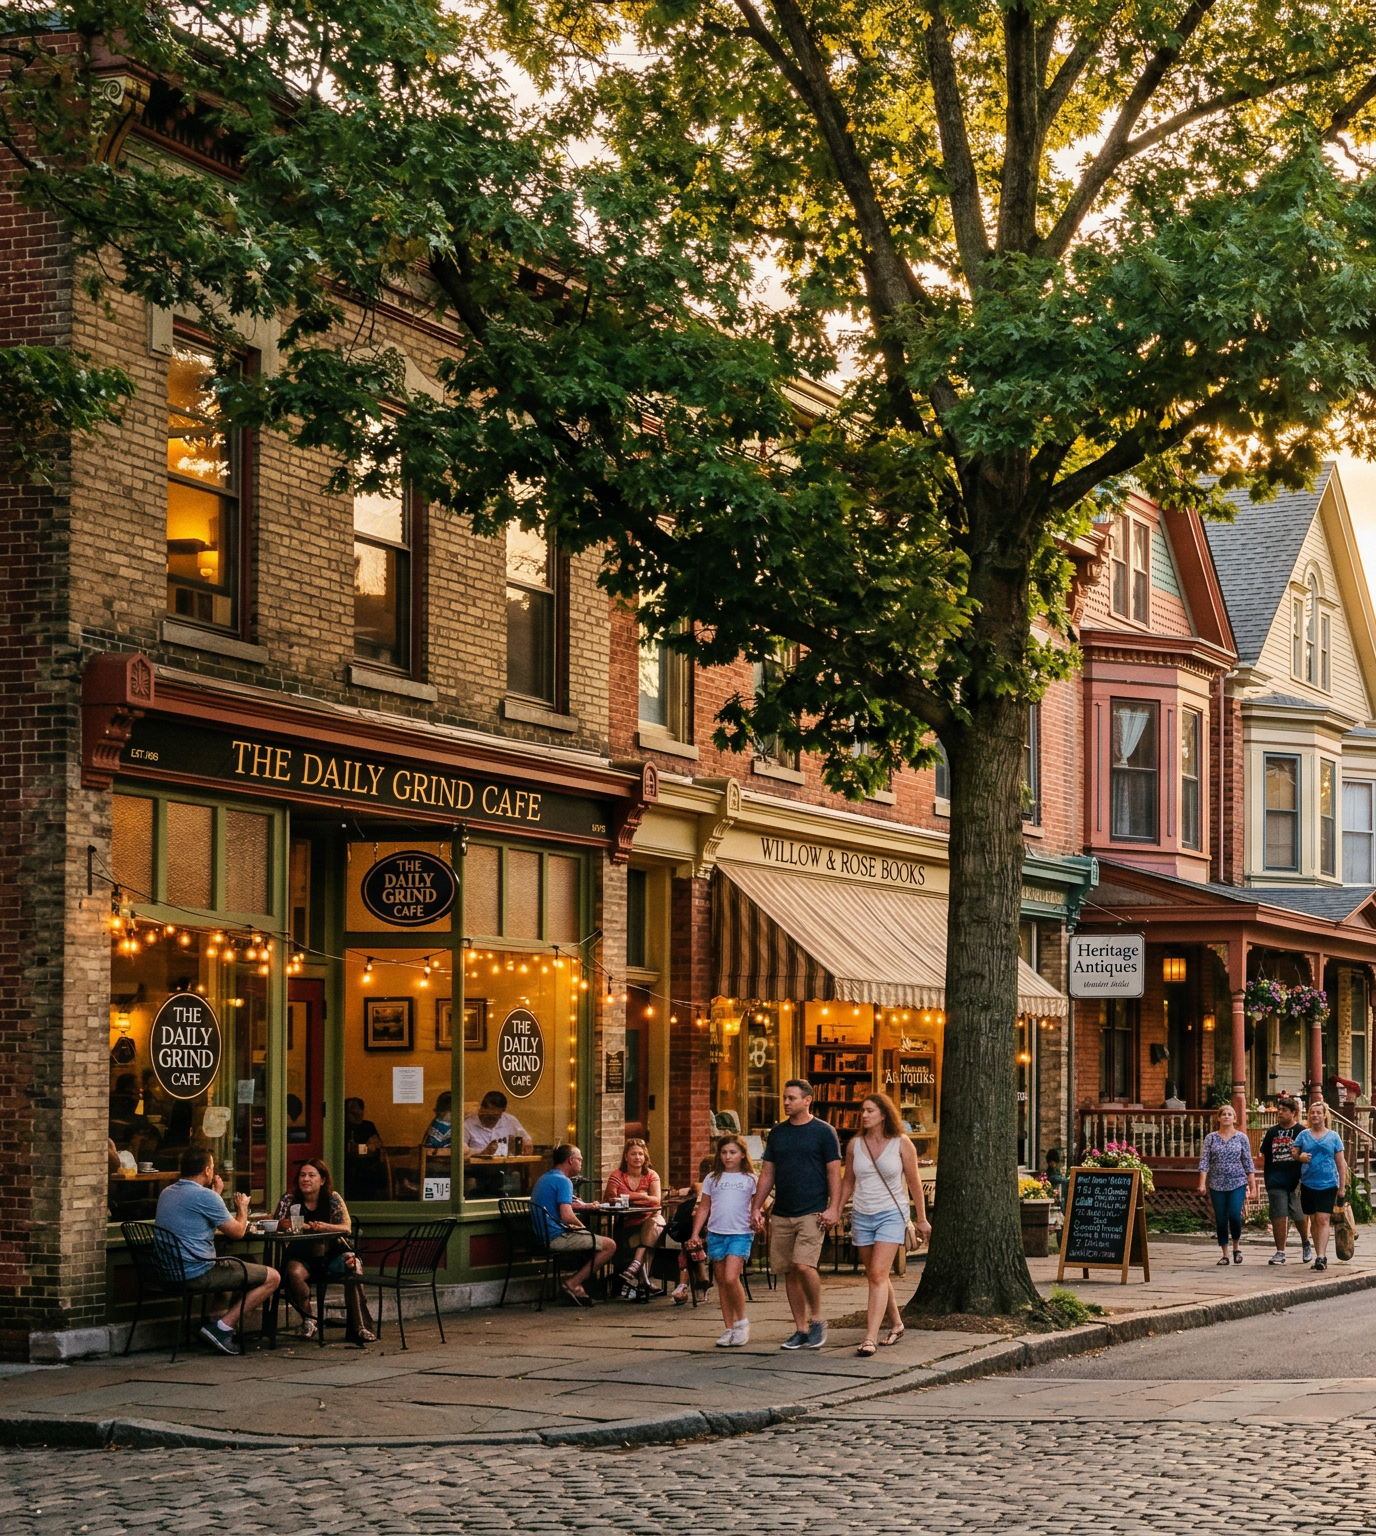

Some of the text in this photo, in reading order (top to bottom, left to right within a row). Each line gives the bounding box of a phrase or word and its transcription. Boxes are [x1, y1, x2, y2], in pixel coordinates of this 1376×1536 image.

[232, 741, 542, 821] THE DAILY GRIND CAFE
[396, 860, 422, 872] THE
[761, 837, 925, 886] WILLOW & ROSE BOOKS
[384, 873, 435, 888] DAILY
[382, 888, 437, 904] GRIND
[393, 905, 425, 917] CAFE
[1078, 943, 1139, 961] Heritage
[1073, 960, 1137, 978] Antiques
[173, 1007, 202, 1023] THE
[161, 1026, 213, 1046] DAILY
[511, 1020, 532, 1034] THE
[503, 1035, 539, 1053] DAILY
[158, 1048, 214, 1069] GRIND
[502, 1054, 540, 1072] GRIND
[171, 1073, 201, 1086] CAFE
